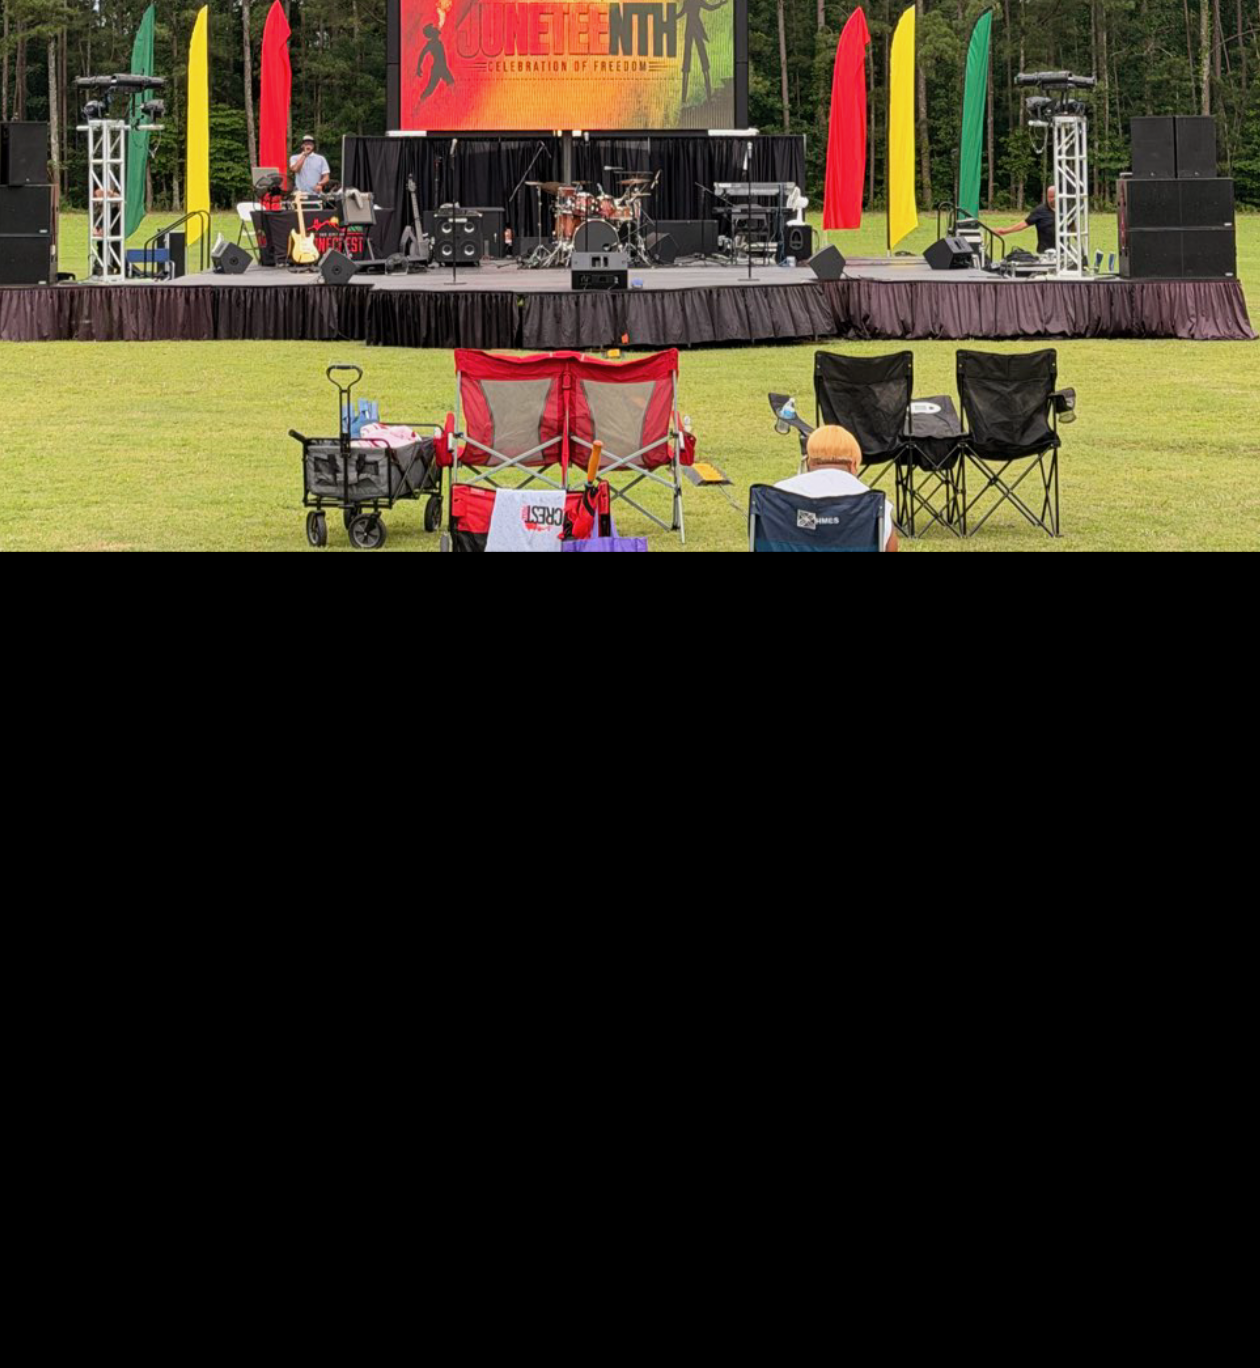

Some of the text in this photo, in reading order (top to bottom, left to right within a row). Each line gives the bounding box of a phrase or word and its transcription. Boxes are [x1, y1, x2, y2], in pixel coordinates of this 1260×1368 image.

[456, 2, 677, 58] JUNETEENTH
[487, 61, 647, 72] CELEBRATION OF FREEDOM
[525, 505, 563, 526] CREST
